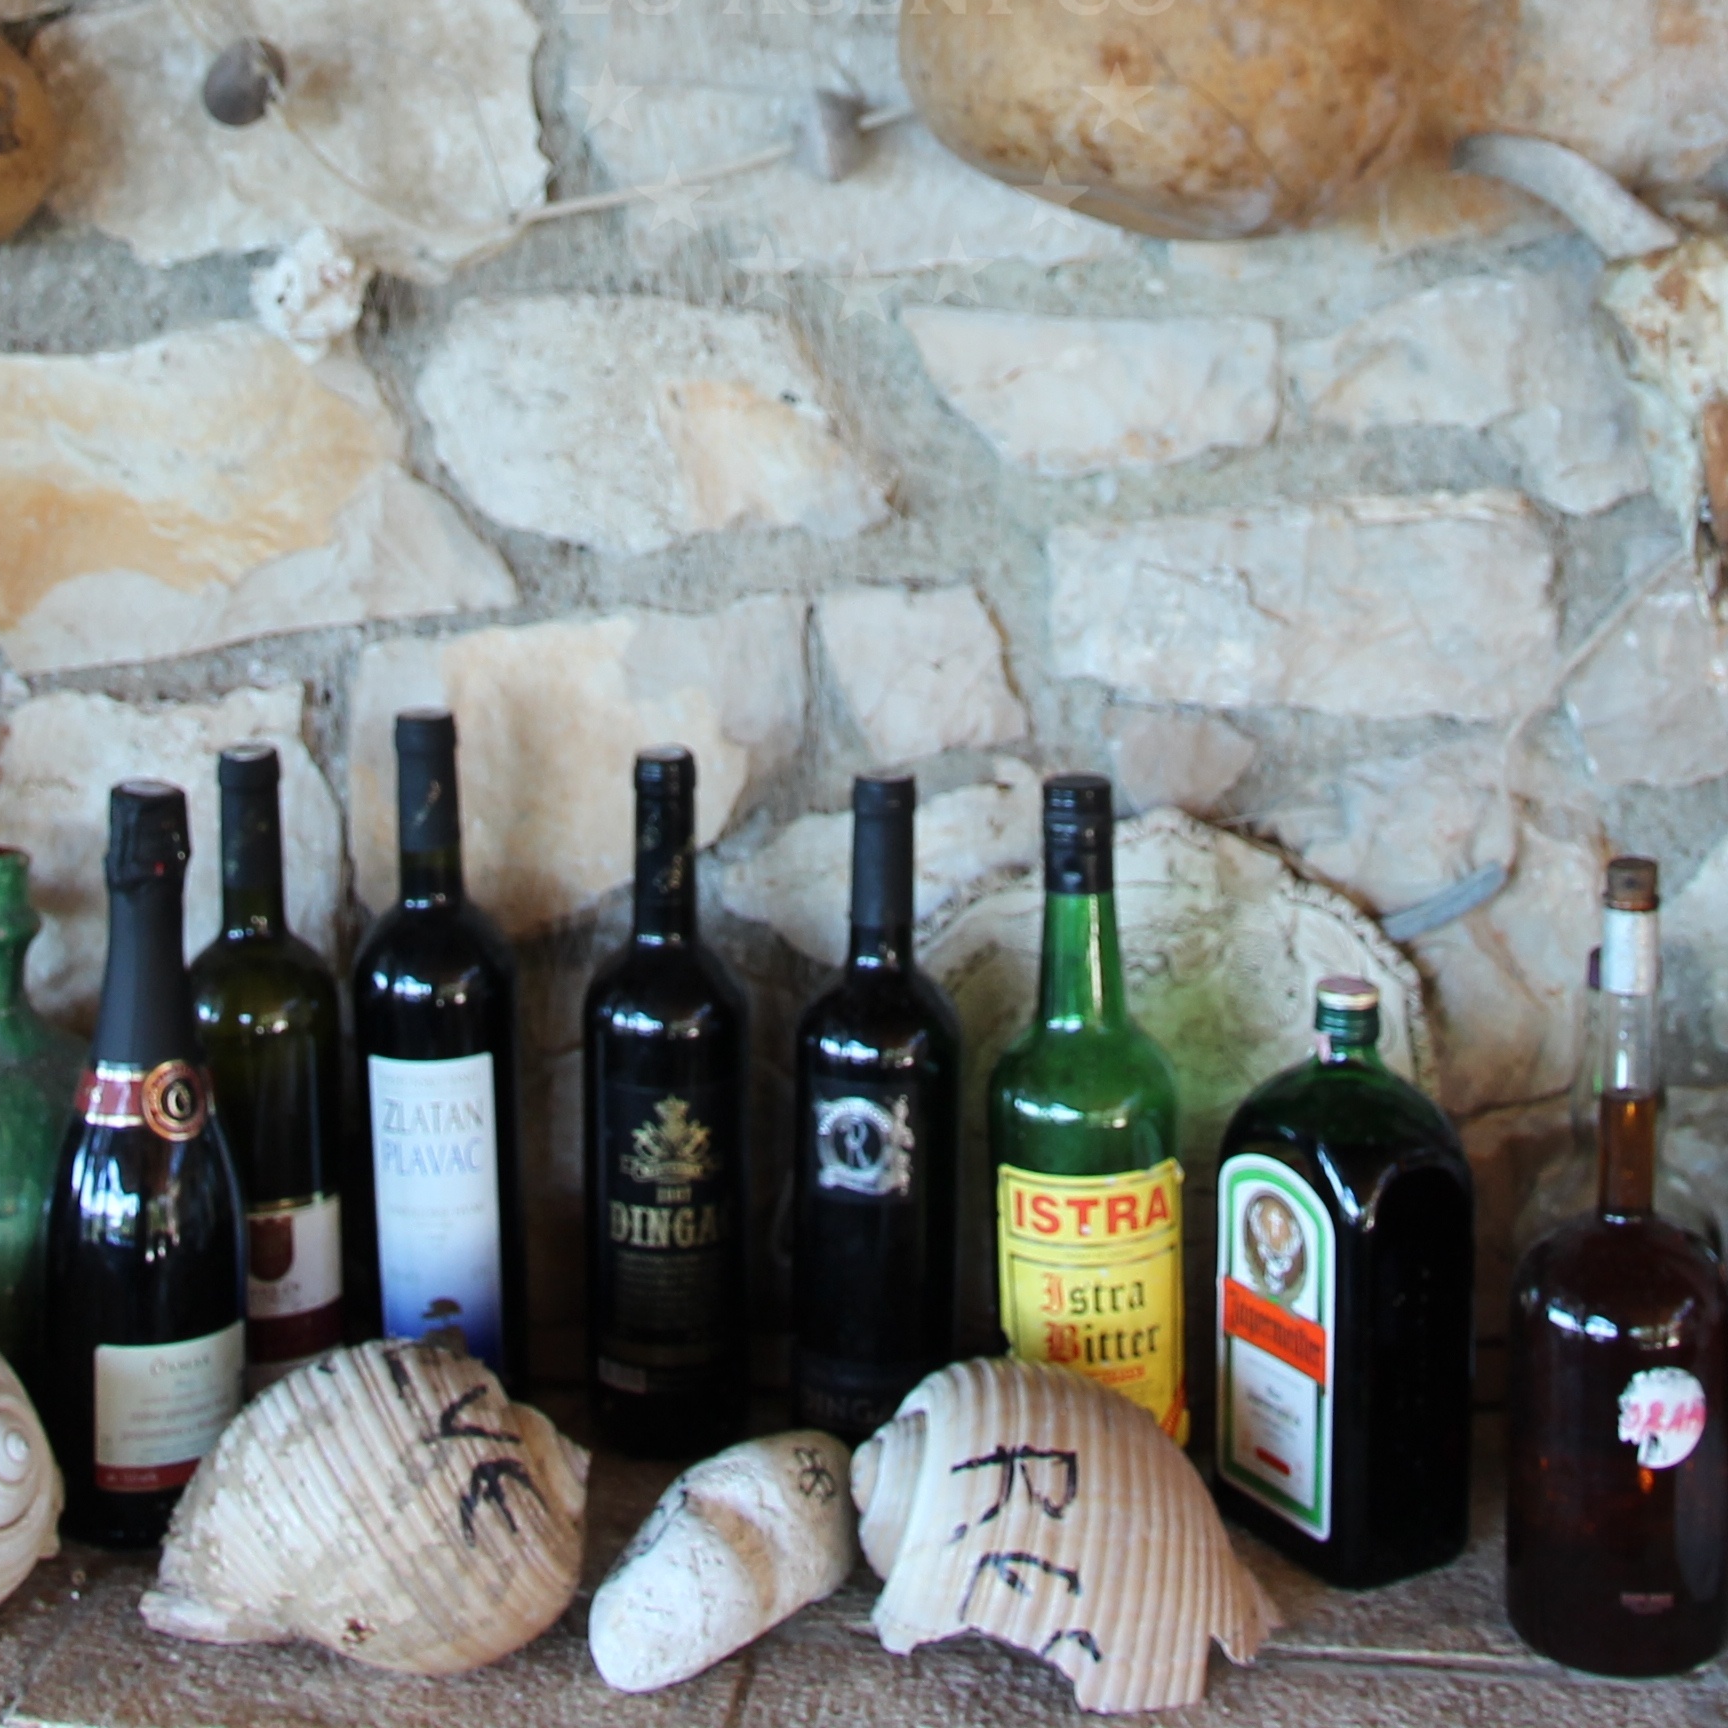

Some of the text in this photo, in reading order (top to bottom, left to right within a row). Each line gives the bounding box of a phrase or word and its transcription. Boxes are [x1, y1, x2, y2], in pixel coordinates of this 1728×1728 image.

[382, 1098, 484, 1135] ZLATAN
[381, 1138, 484, 1176] PLAVAC
[609, 1200, 724, 1249] DINGA
[1014, 1186, 1169, 1236] ISTRA
[1041, 1272, 1145, 1314] Istra
[1045, 1321, 1160, 1364] Bitter
